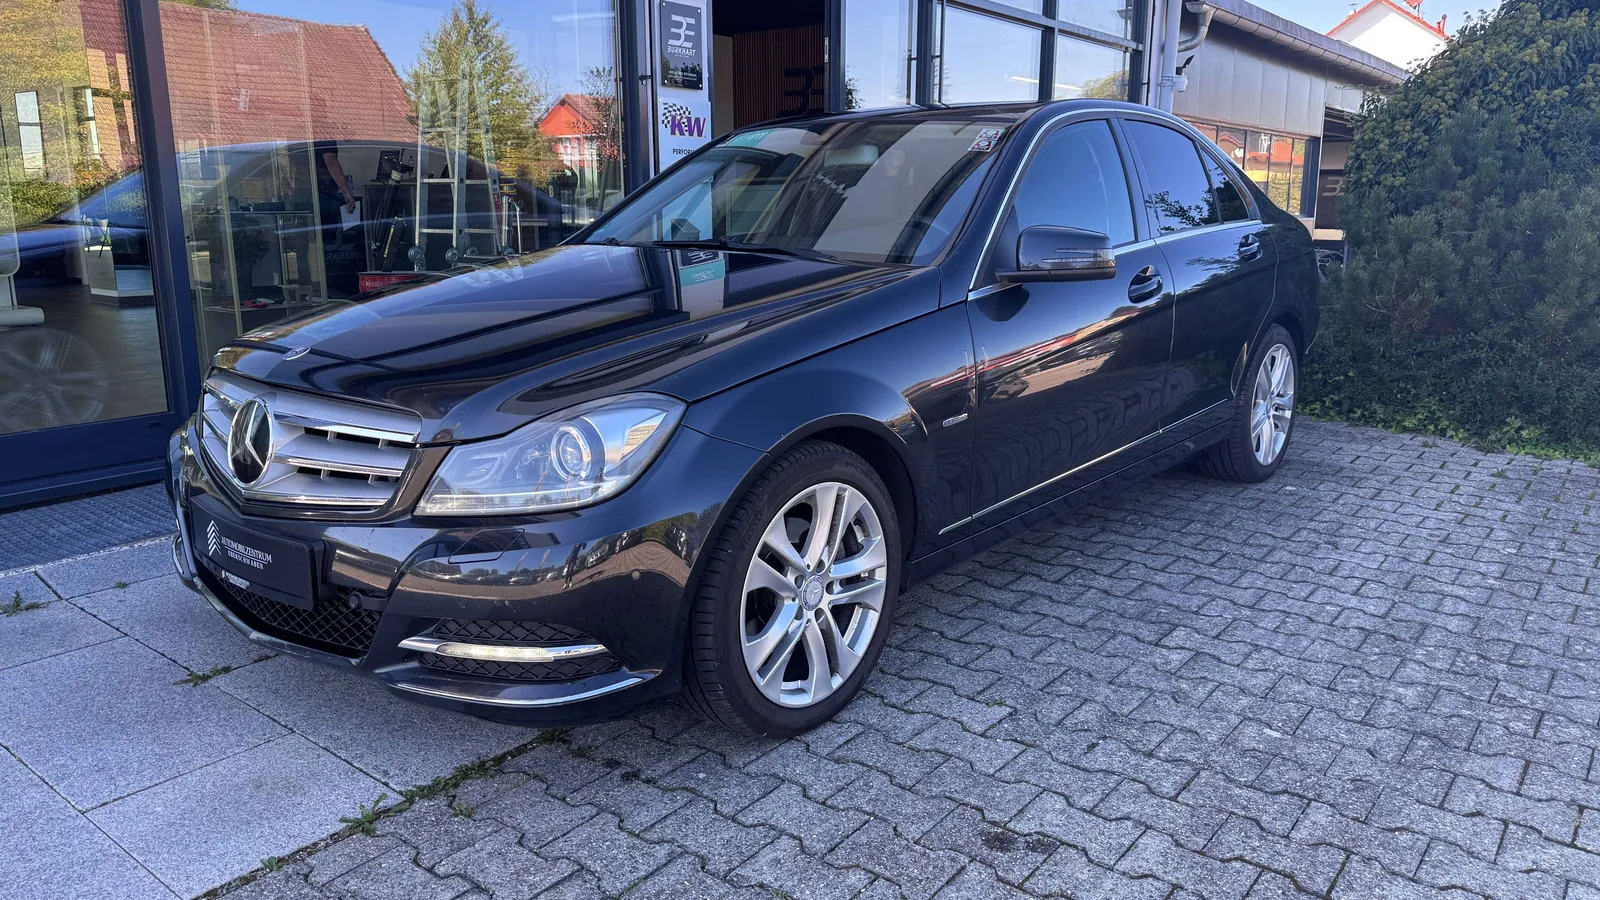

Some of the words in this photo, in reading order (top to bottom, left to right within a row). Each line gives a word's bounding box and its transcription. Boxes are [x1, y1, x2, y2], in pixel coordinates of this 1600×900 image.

[667, 45, 696, 57] BURKHART
[670, 114, 706, 139] KW
[221, 536, 272, 563] AUTOMOBILZENTRUM
[227, 550, 264, 570] OBERSCHWABEN
